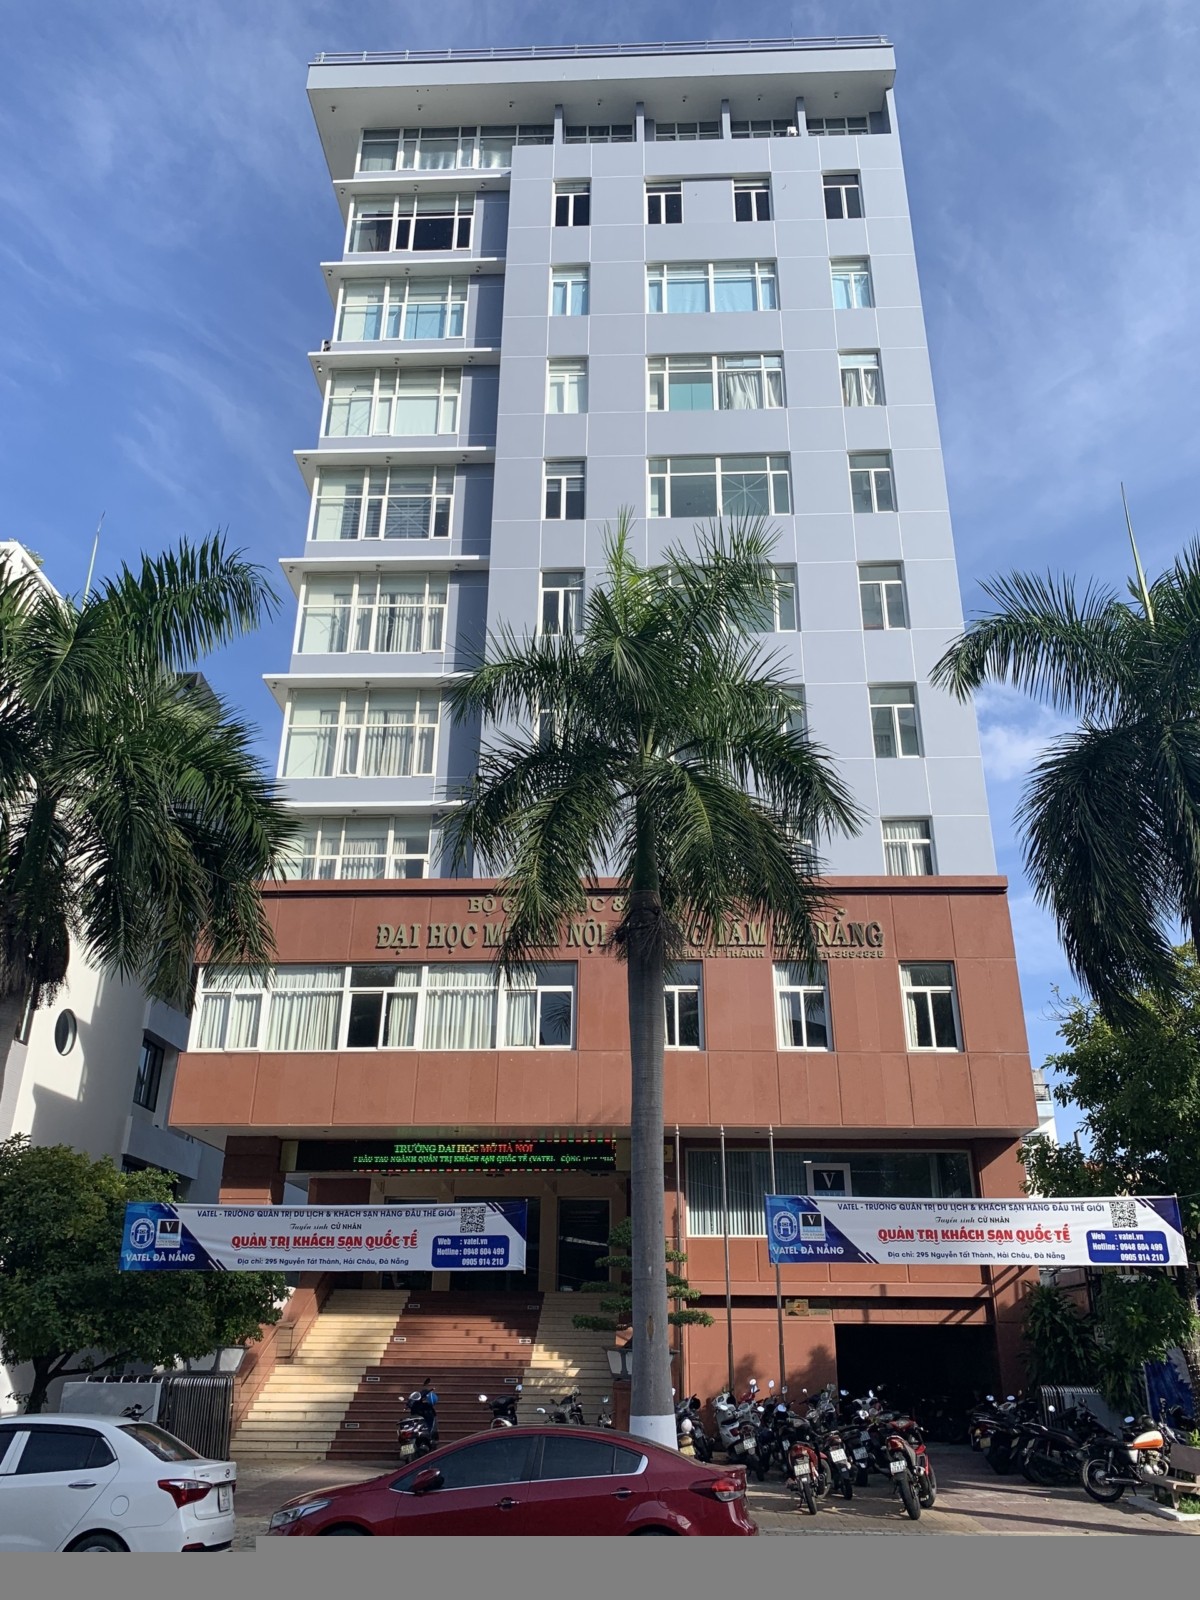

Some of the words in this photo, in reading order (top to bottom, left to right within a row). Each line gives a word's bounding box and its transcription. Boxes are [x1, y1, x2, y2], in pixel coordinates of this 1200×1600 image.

[468, 894, 497, 916] BỘ
[376, 923, 421, 955] ĐẠI
[427, 923, 477, 954] HỌC
[821, 1172, 836, 1189] V
[837, 1203, 859, 1211] VATEL
[924, 1203, 936, 1213] TRỊ
[937, 1203, 949, 1211] DU
[951, 1203, 969, 1213] LỊCH
[970, 1203, 976, 1211] &
[978, 1202, 1007, 1211] KHÁCH
[1008, 1203, 1025, 1213] SẠN
[281, 1210, 292, 1220] TRỊ
[293, 1210, 305, 1218] DU
[306, 1210, 324, 1220] LỊCH
[333, 1209, 361, 1217] KHÁCH
[362, 1210, 379, 1219] SẠN
[807, 1215, 816, 1226] V
[977, 1216, 988, 1224] CỬ
[990, 1216, 1010, 1224] NHÂN
[165, 1221, 175, 1233] V
[330, 1222, 341, 1230] CỬ
[342, 1222, 362, 1230] NHÂN
[878, 1226, 916, 1242] QUẢN
[917, 1229, 939, 1245] TRỊ
[941, 1226, 984, 1241] KHÁCH
[987, 1229, 1013, 1244] SẠN
[1016, 1224, 1052, 1244] QUỐC
[1055, 1223, 1071, 1241] TẾ
[1091, 1232, 1106, 1240] Web
[1118, 1232, 1144, 1240] vatel.vn
[232, 1232, 269, 1248] QUẢN
[270, 1235, 291, 1251] TRỊ
[293, 1233, 335, 1247] KHÁCH
[338, 1235, 363, 1251] SẠN
[365, 1230, 401, 1249] QUỐC
[403, 1229, 418, 1247] TẾ
[437, 1238, 451, 1246] Web
[463, 1238, 488, 1246] vatel.vn
[463, 1248, 478, 1256] 0948
[480, 1248, 492, 1256] 604
[493, 1248, 505, 1256] 499
[773, 1246, 798, 1254] VATEL
[801, 1244, 814, 1254] ĐÀ
[1120, 1243, 1136, 1251] 0948
[1137, 1243, 1149, 1251] 604
[1150, 1243, 1162, 1251] 499
[126, 1253, 150, 1262] VATEL
[153, 1251, 166, 1262] ĐÀ
[972, 1251, 995, 1259] Thành,
[1011, 1251, 1032, 1259] Châu,
[1120, 1253, 1137, 1261] 0905
[1138, 1253, 1150, 1261] 914
[1151, 1253, 1164, 1261] 210
[462, 1258, 477, 1266] 0905
[479, 1258, 491, 1266] 914
[492, 1258, 504, 1266] 210
